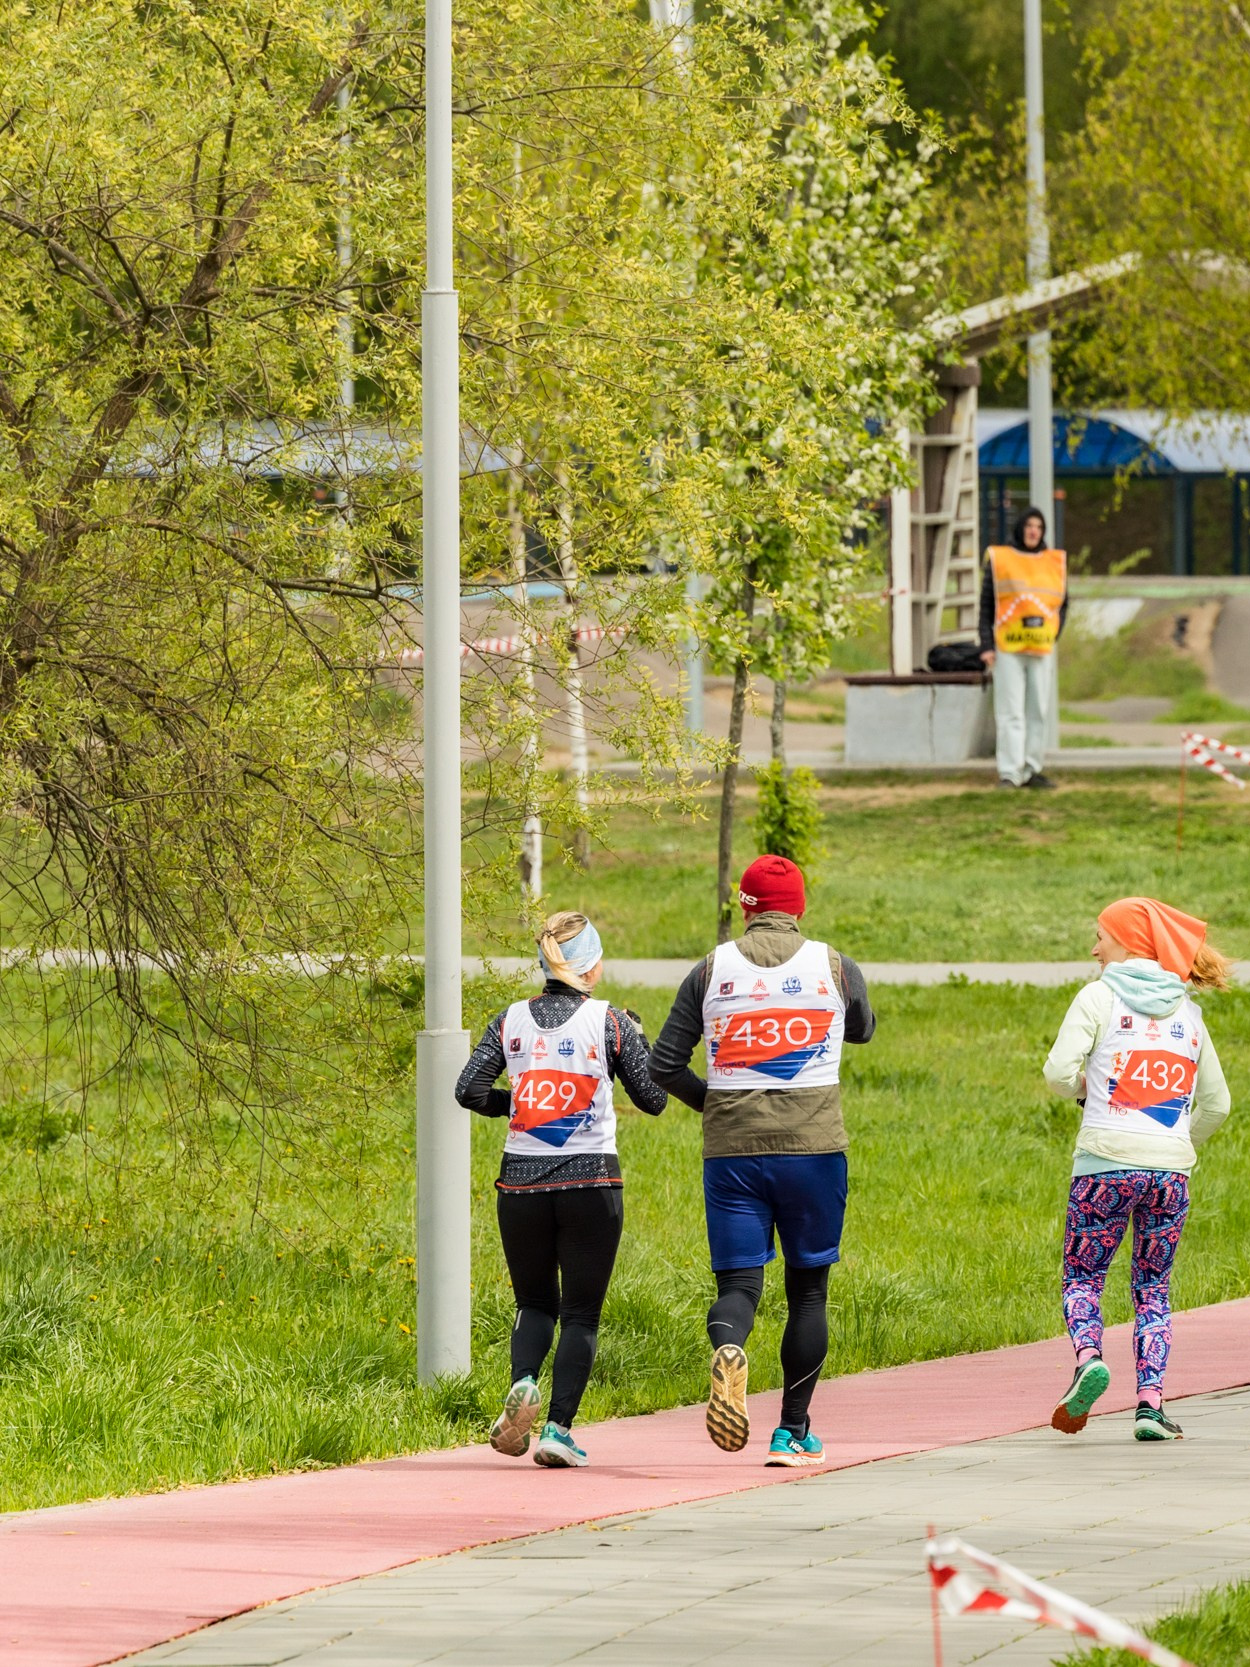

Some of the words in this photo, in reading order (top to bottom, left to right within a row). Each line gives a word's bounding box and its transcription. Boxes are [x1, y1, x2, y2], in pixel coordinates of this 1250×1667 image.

[730, 1016, 813, 1048] 430
[1130, 1059, 1186, 1093] 432
[518, 1079, 577, 1111] 429
